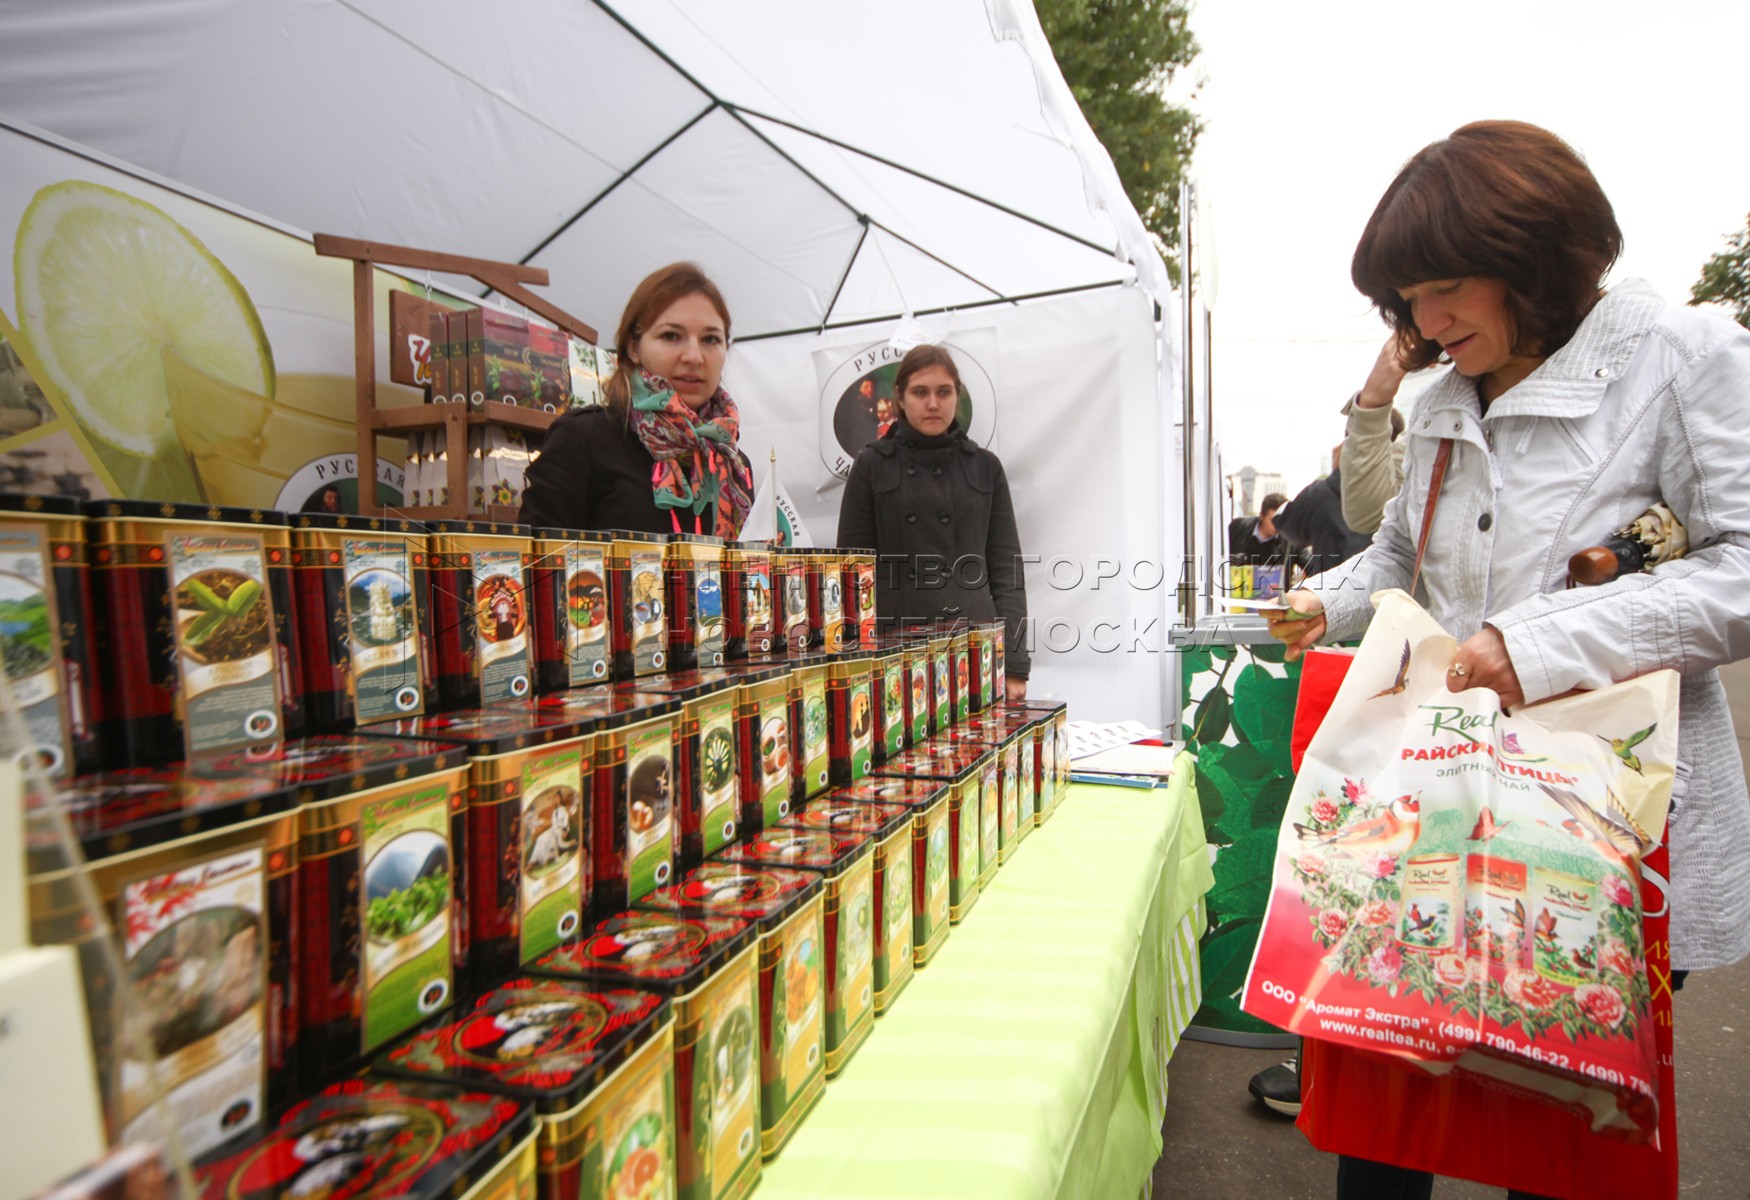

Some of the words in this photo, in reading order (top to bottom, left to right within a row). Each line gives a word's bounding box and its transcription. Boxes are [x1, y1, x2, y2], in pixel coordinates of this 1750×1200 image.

[854, 346, 903, 372] РУСС
[776, 495, 801, 536] РУССКАЯ
[1261, 980, 1295, 1004] ООО
[1299, 996, 1361, 1019] "Аромат
[1438, 1022, 1481, 1042] (499)
[1579, 1061, 1625, 1087] (499)
